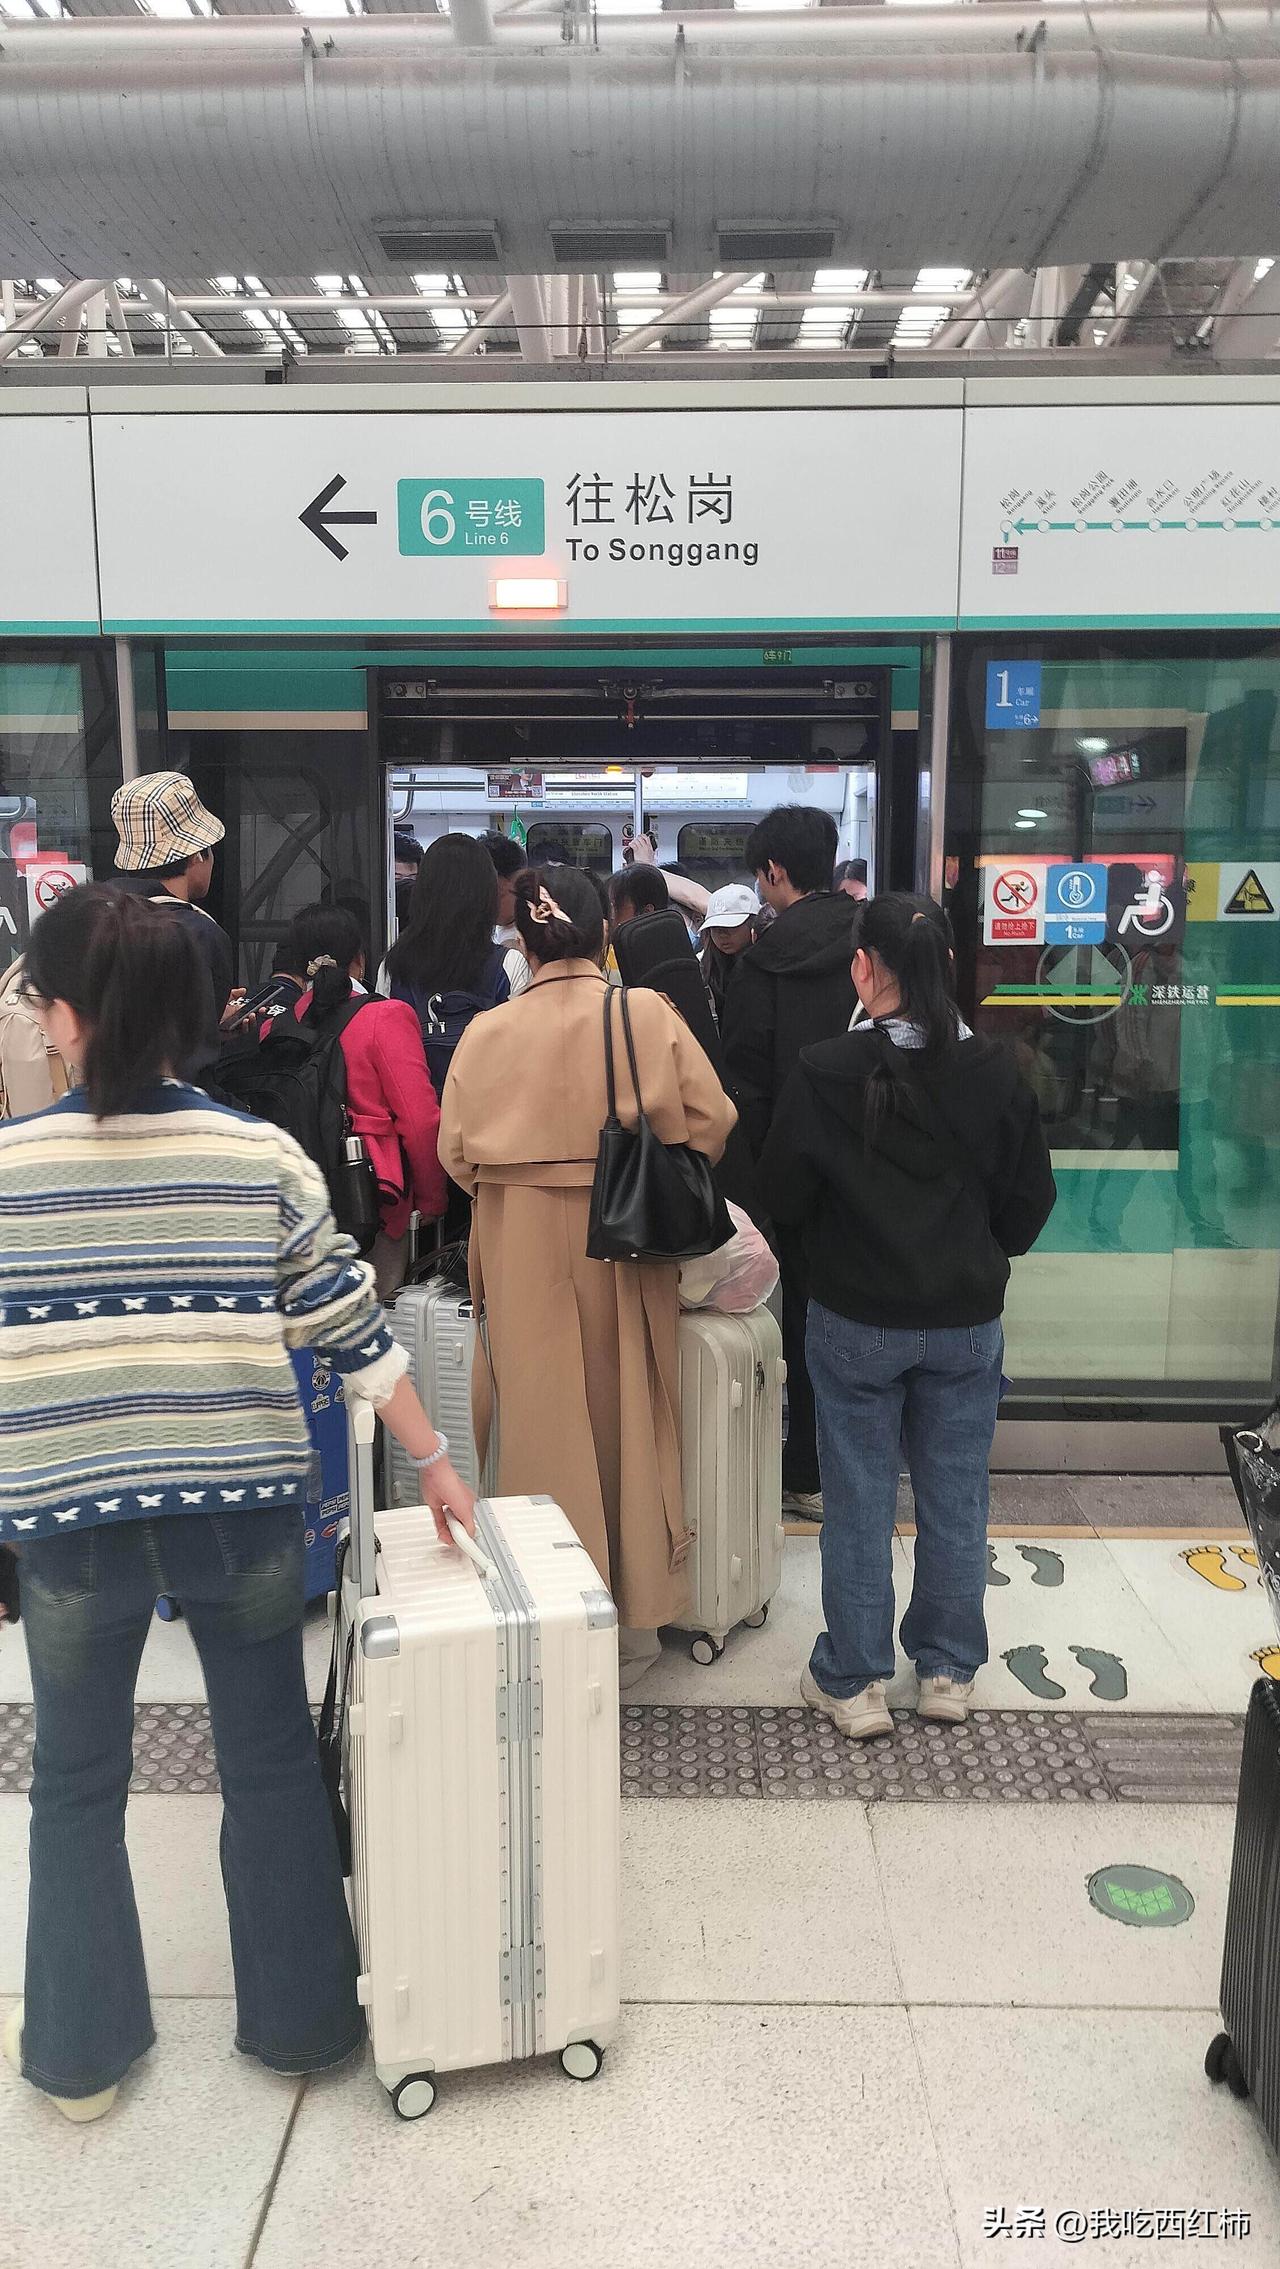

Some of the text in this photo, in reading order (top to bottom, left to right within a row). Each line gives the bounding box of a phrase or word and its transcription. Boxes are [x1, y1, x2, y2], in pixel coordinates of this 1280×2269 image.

[565, 472, 733, 527] 往松岗
[1000, 488, 1020, 509] 松岗
[1070, 470, 1109, 508] 松岗公园
[465, 532, 509, 546] Line 6
[566, 538, 759, 566] To Songgang
[996, 669, 1013, 707] 1
[1023, 713, 1032, 725] 6
[1065, 925, 1073, 939] 1
[1151, 984, 1210, 1000] 深铁运营
